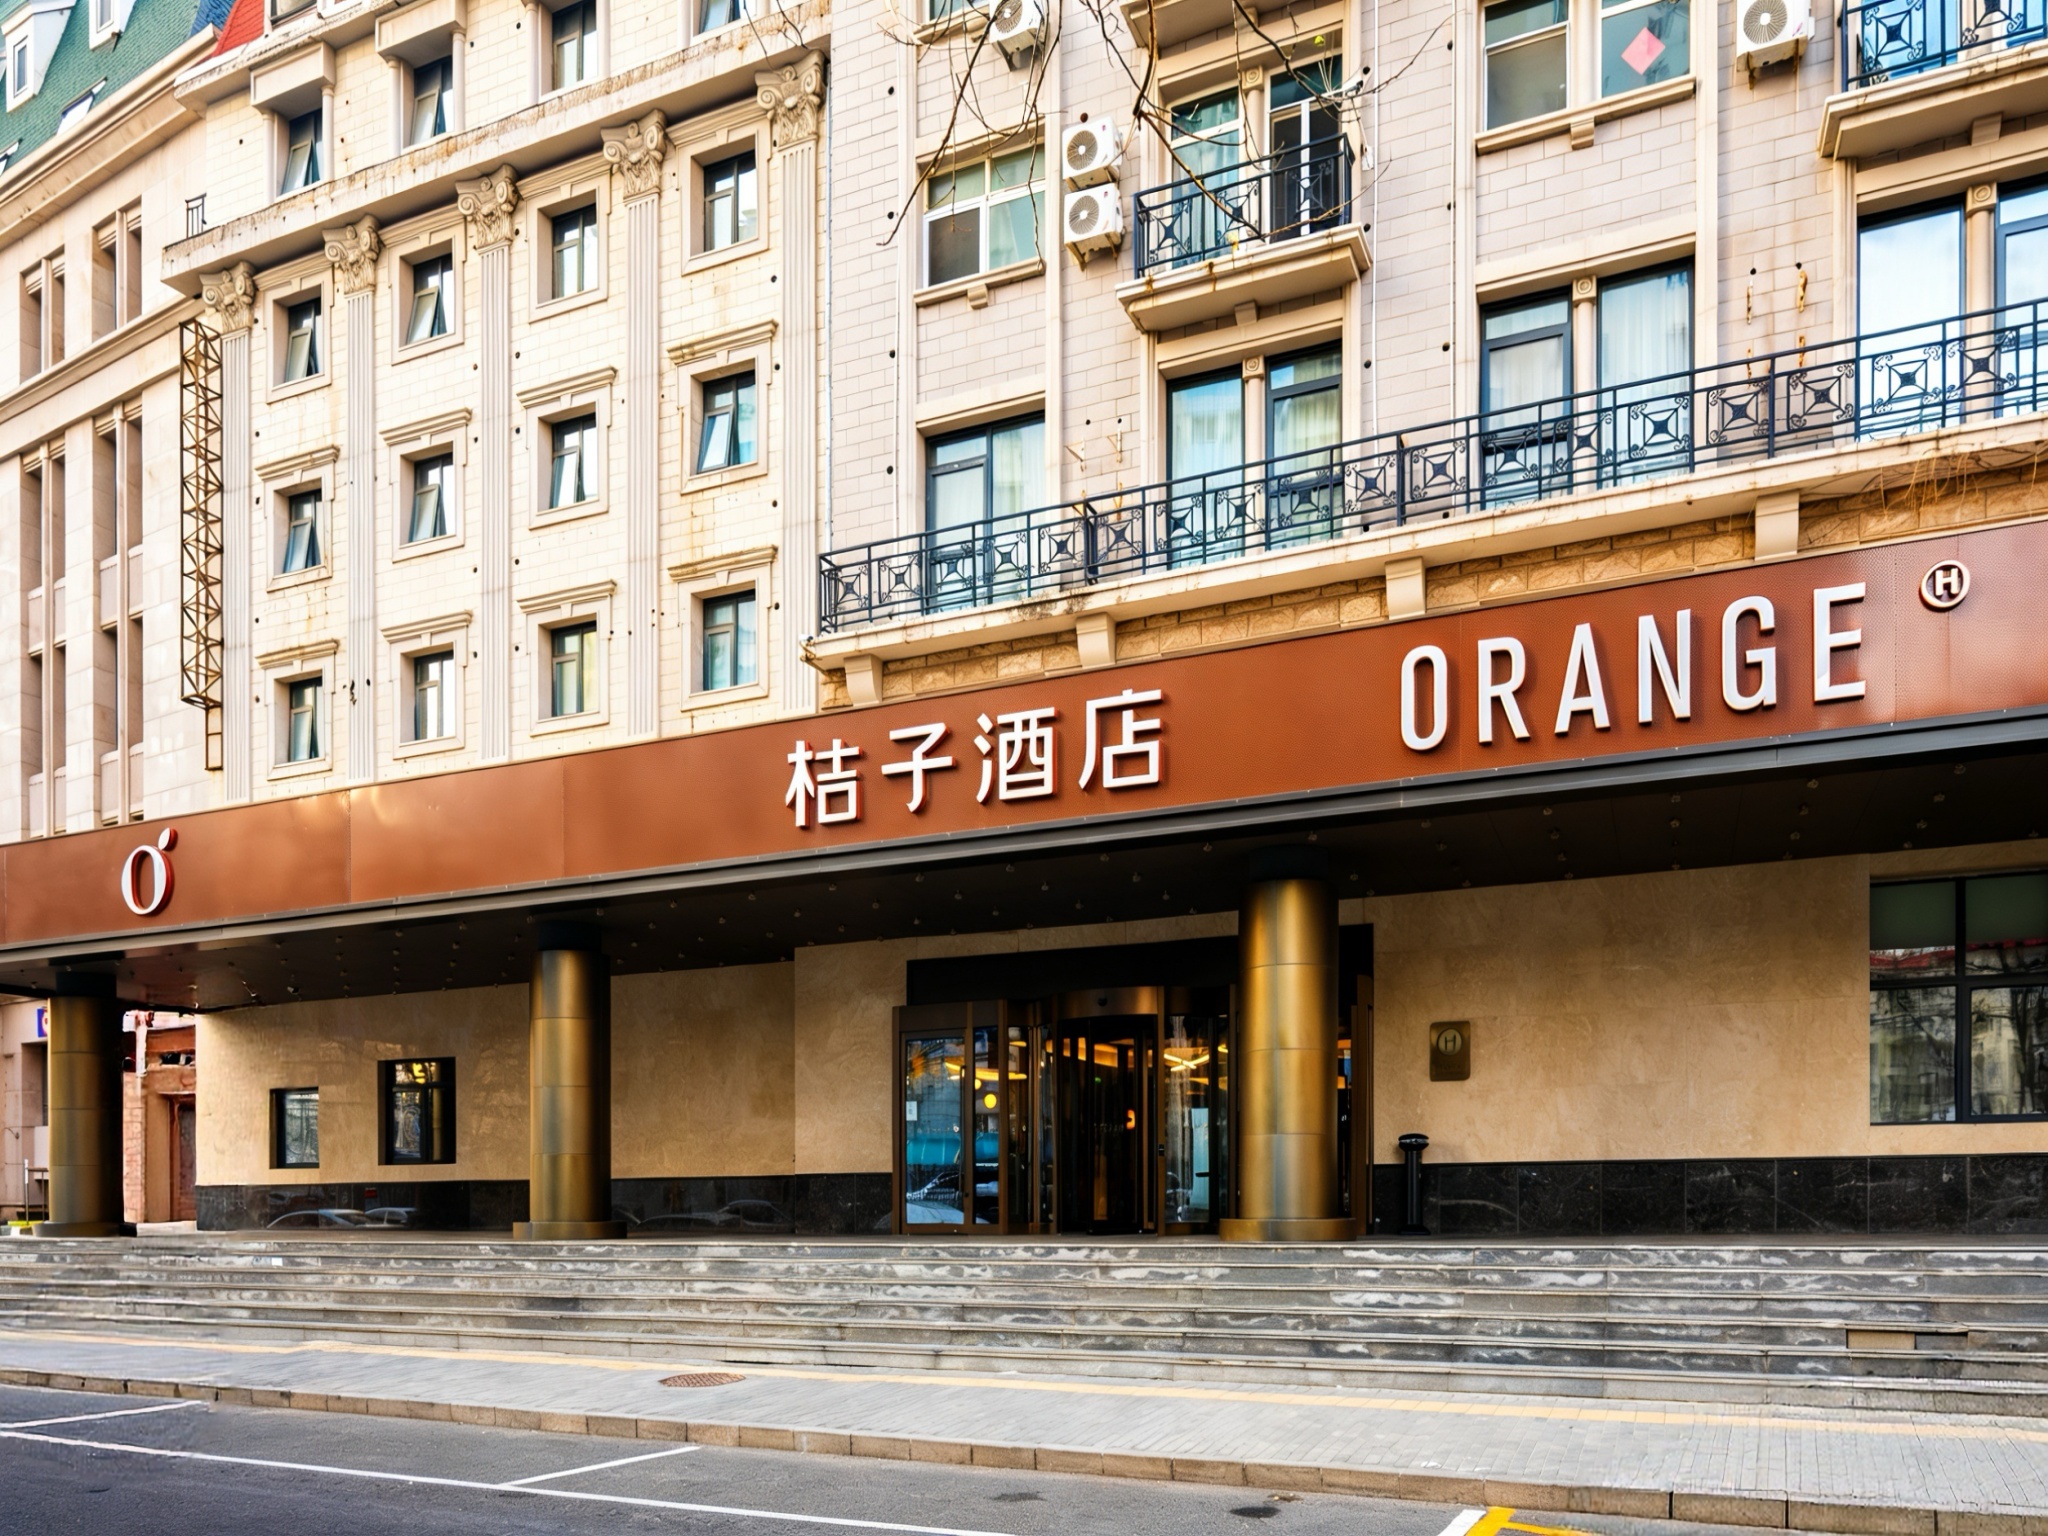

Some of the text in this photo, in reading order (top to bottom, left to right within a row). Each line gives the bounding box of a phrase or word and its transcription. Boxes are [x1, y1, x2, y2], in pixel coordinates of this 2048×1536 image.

[1400, 582, 1867, 751] ORANGE
[785, 689, 1165, 828] 桔子酒店
